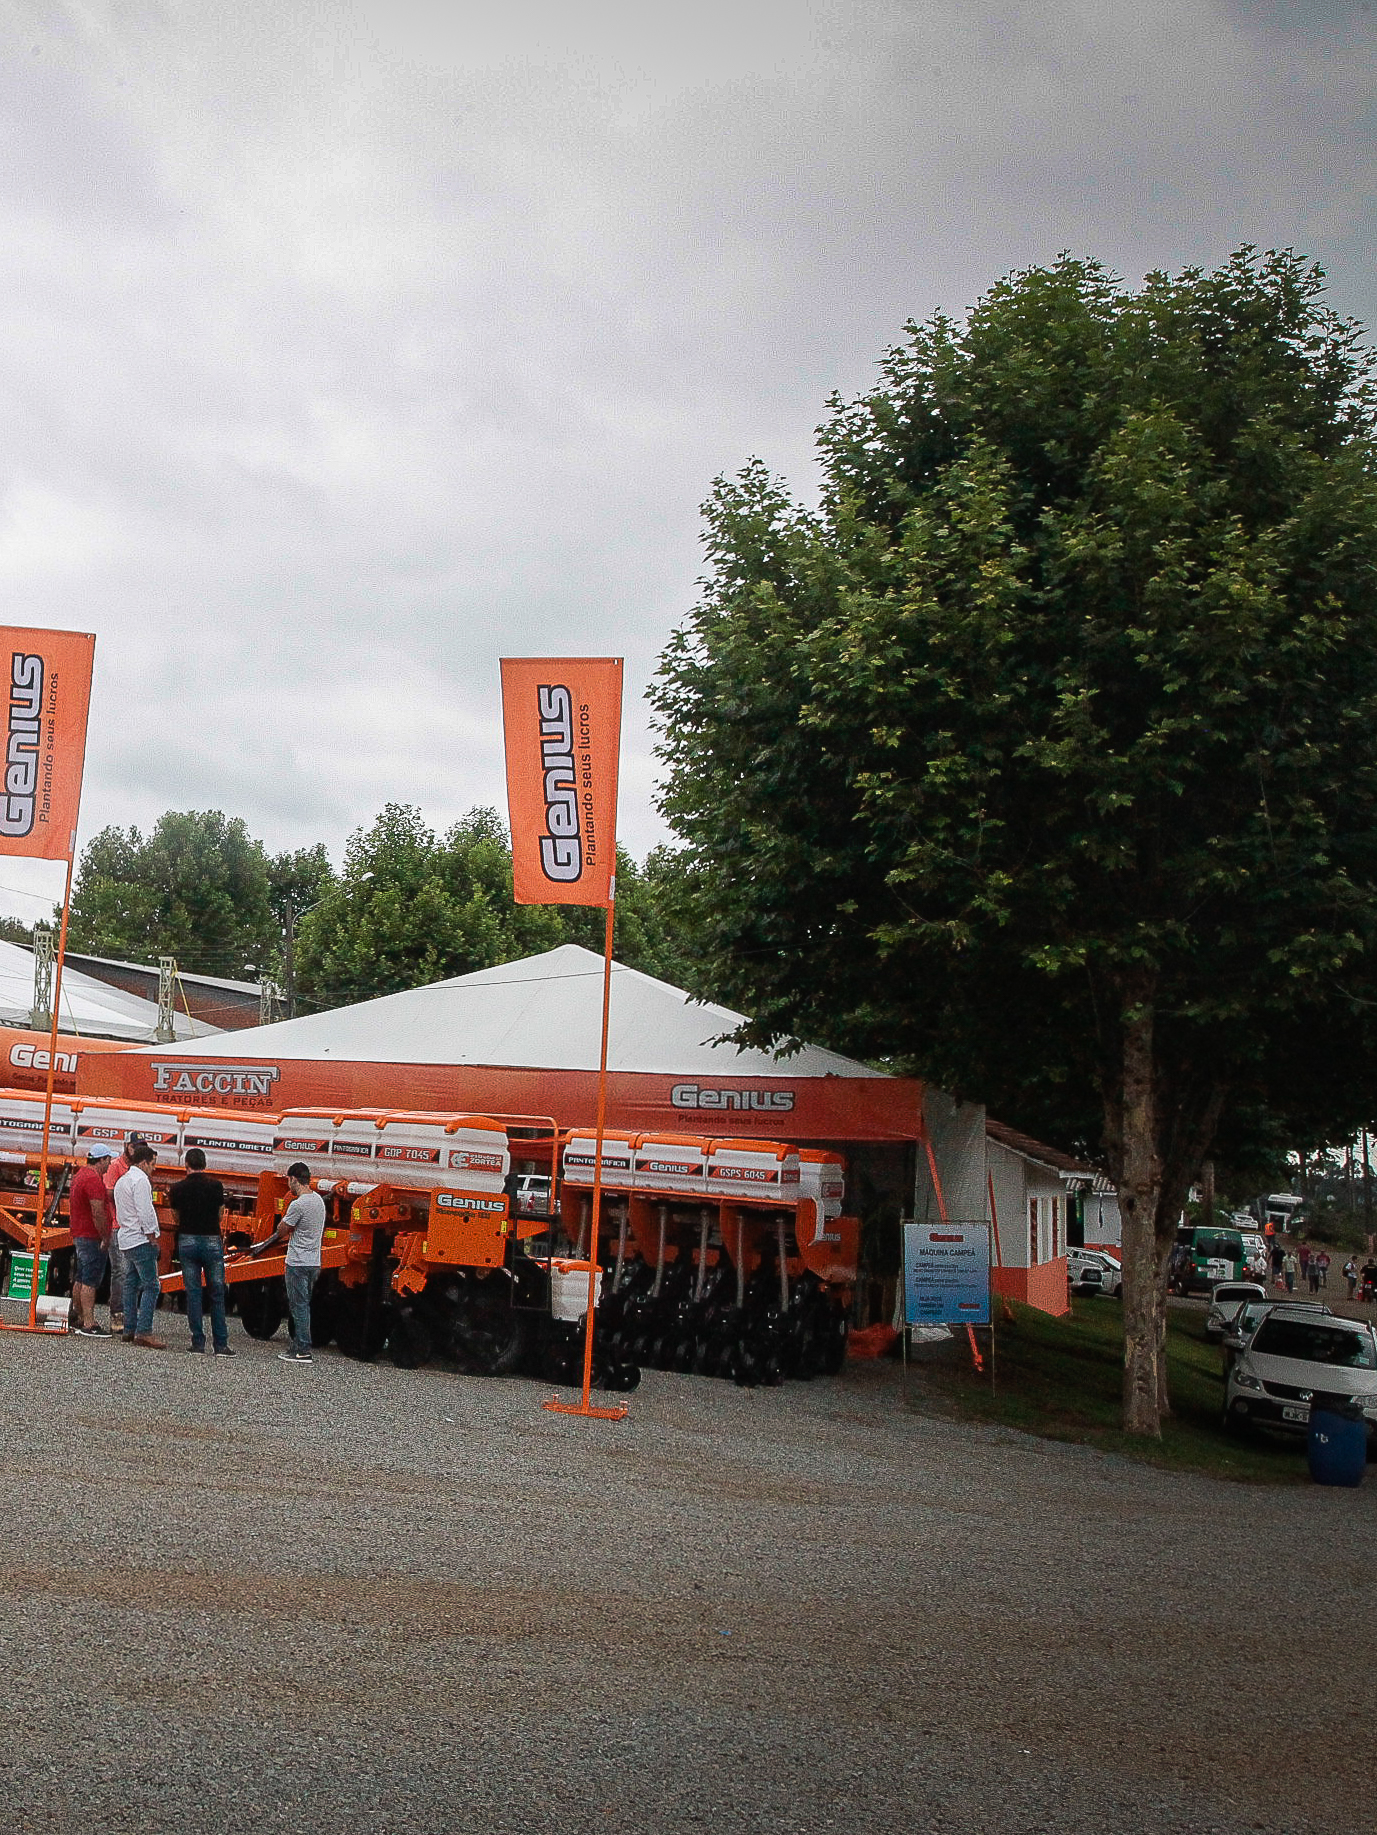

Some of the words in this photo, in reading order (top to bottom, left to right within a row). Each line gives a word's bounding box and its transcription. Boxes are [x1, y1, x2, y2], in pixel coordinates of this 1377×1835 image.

[46, 673, 58, 715] lucros
[578, 703, 590, 749] lucros
[537, 684, 582, 883] Genius
[581, 754, 592, 789] seus
[39, 754, 54, 823] Plantando
[582, 793, 596, 866] Plantando
[9, 1043, 78, 1073] Geni
[150, 1062, 280, 1096] FACCIN
[156, 1094, 216, 1105] TRATORES
[220, 1096, 229, 1105] E
[233, 1097, 274, 1109] PEÇAS
[671, 1083, 795, 1111] Genius
[92, 1128, 119, 1138] GSP
[197, 1139, 236, 1148] PLANTIO
[284, 1140, 317, 1151] Genius
[406, 1149, 429, 1160] 7045
[649, 1162, 689, 1173] Genius
[744, 1170, 765, 1180] 6045
[437, 1193, 505, 1212] Genius
